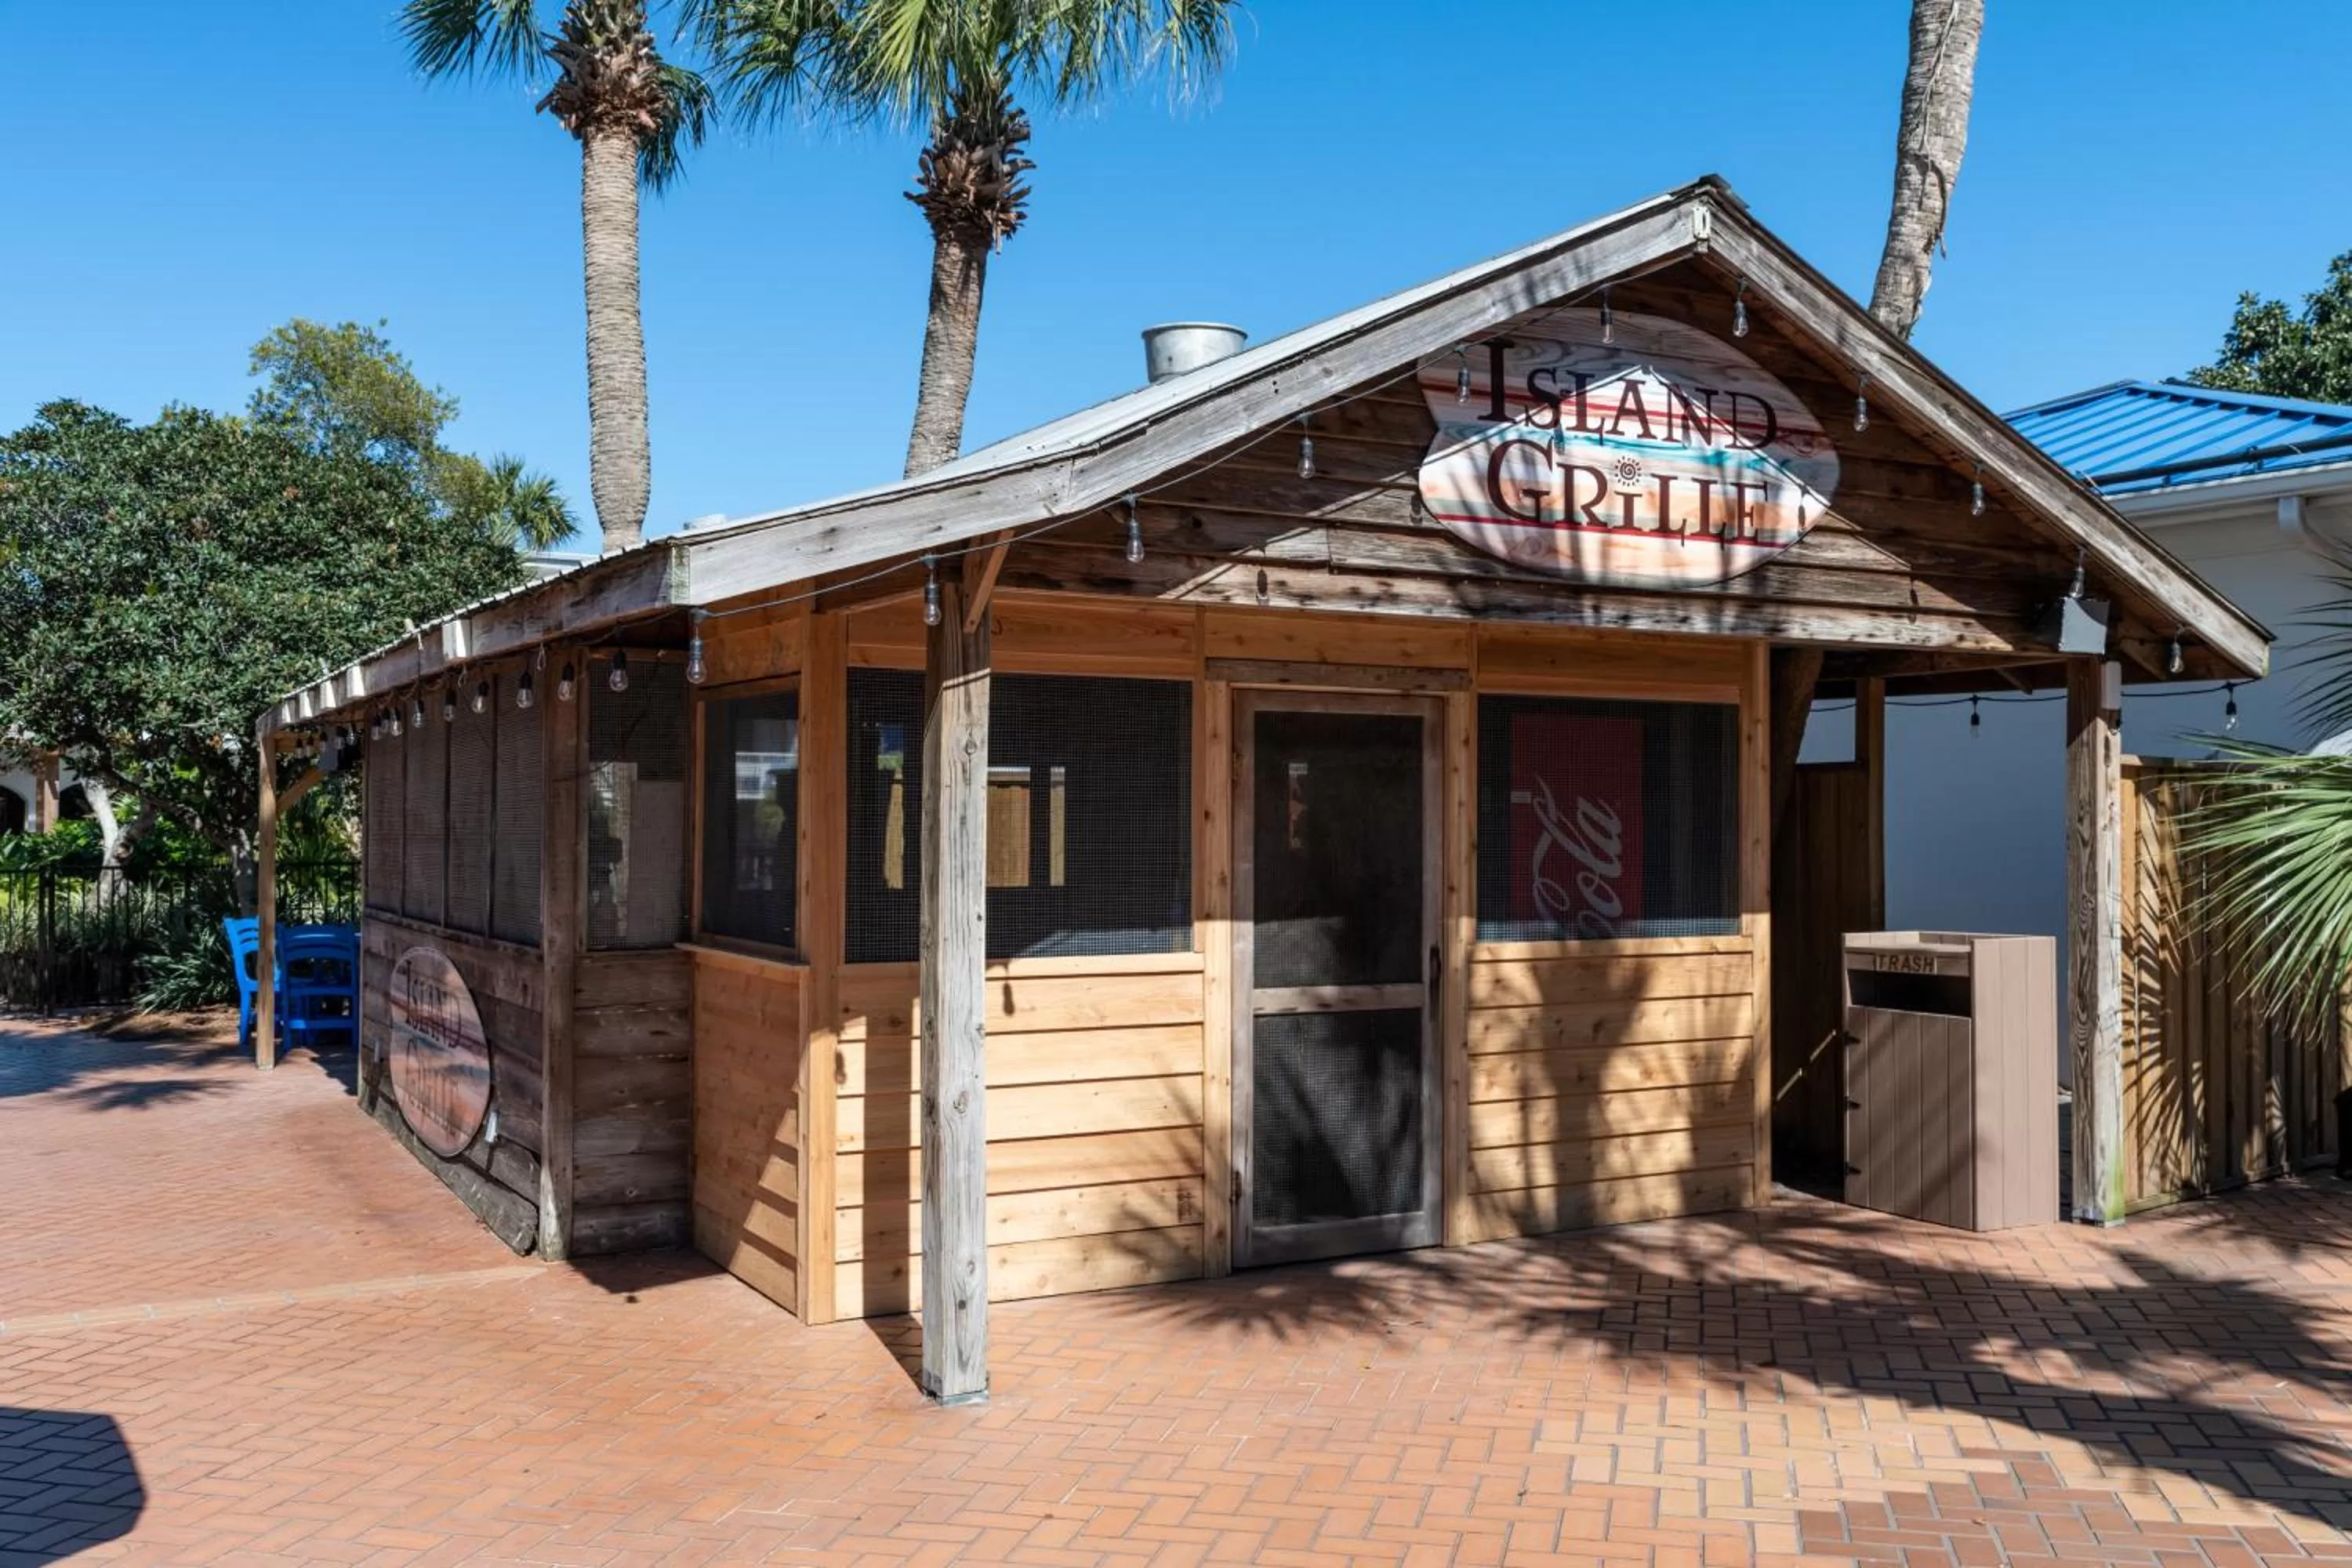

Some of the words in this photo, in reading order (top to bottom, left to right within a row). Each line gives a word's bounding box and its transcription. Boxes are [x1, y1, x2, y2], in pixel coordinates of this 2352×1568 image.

[1477, 339, 1777, 452] ISLAND
[1486, 437, 1769, 545] GRILLE
[405, 959, 462, 1048] ISLAND
[1875, 954, 1934, 973] TRASH
